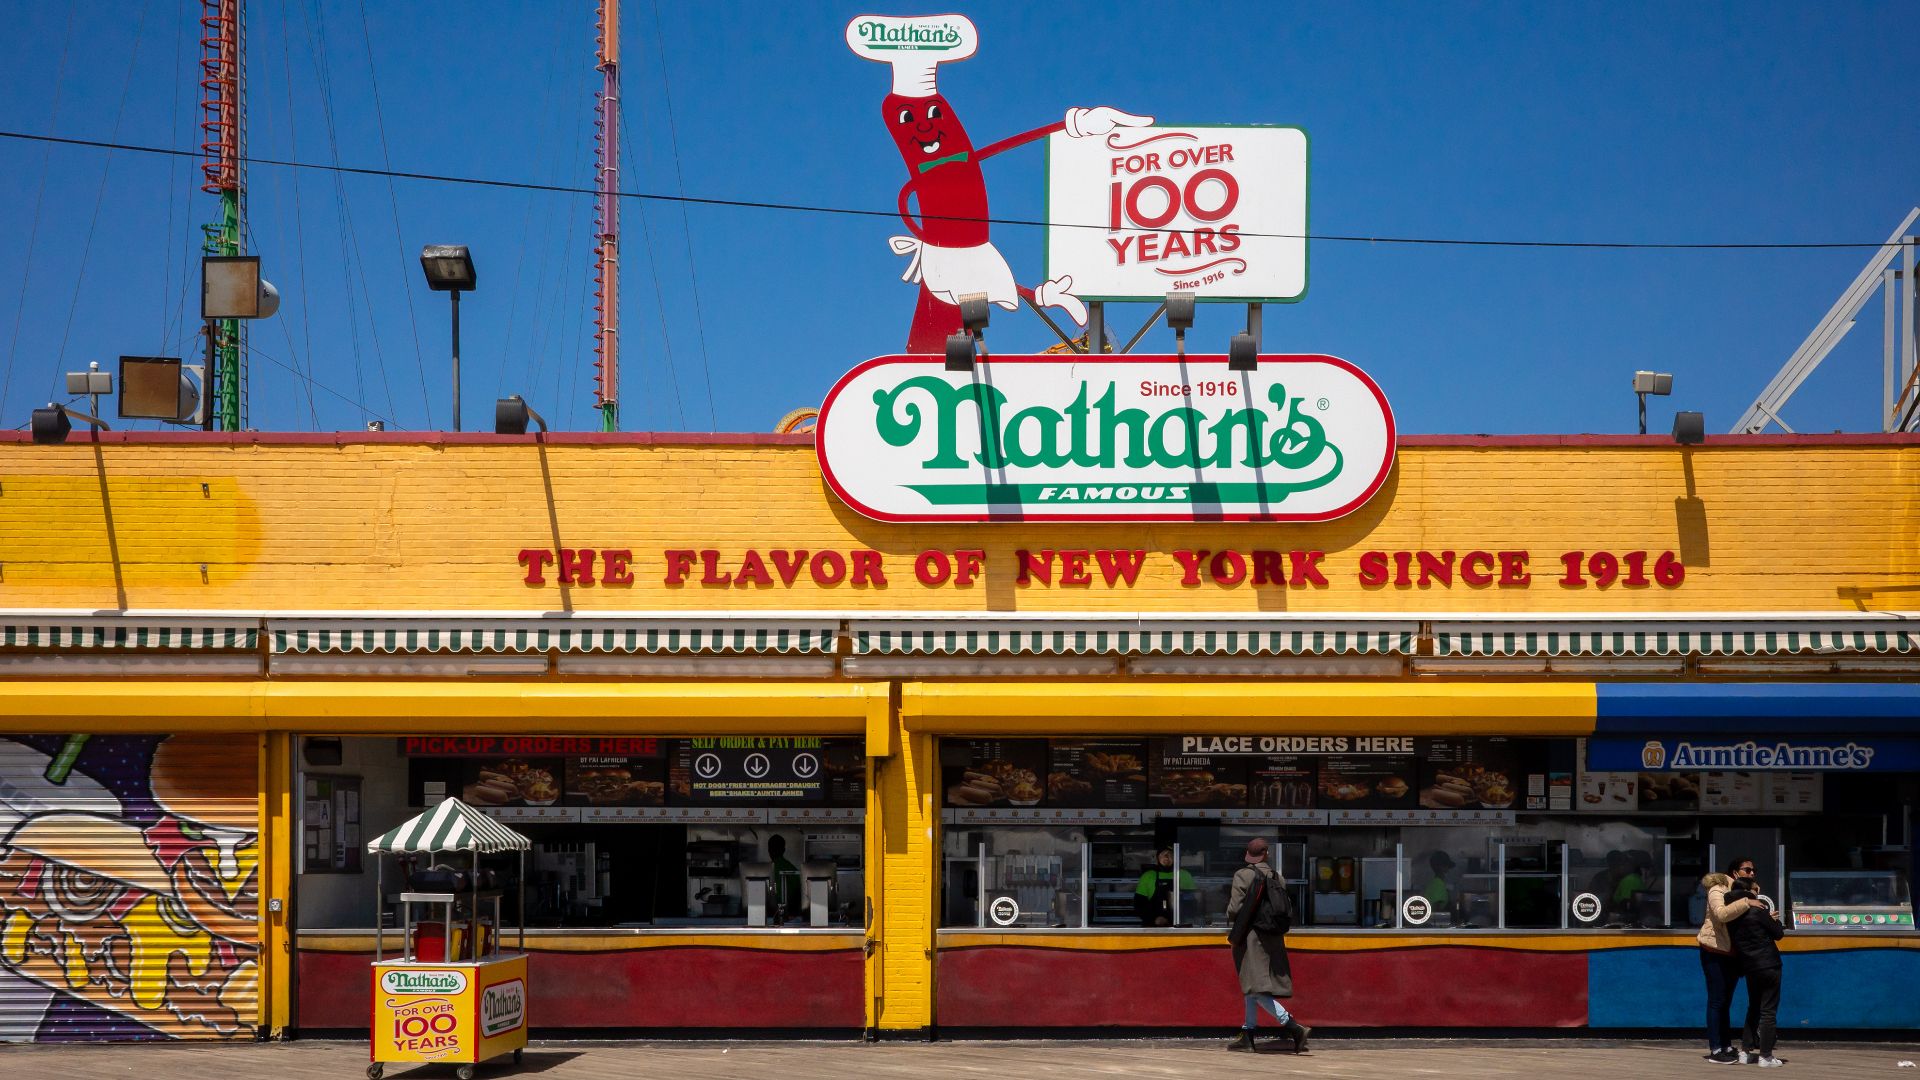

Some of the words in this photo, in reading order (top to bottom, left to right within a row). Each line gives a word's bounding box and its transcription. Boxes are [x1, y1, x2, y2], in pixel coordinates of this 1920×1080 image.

[858, 21, 962, 43] Nathan's
[1111, 152, 1162, 176] FOR
[1168, 143, 1235, 169] OVER
[1110, 168, 1240, 233] 100
[1107, 223, 1241, 265] YEARS
[1173, 278, 1201, 291] Since
[1202, 270, 1226, 287] 1916
[1139, 381, 1192, 397] Since
[1197, 381, 1238, 397] 1916
[873, 376, 1344, 474] Nathan's
[1037, 486, 1190, 501] FAMOUS
[518, 549, 635, 589] THE
[664, 549, 889, 589] FLAVOR
[914, 549, 986, 589] OF
[1015, 549, 1147, 589] NEW
[1174, 549, 1330, 589] YORK
[1358, 549, 1532, 589] SINCE
[1559, 549, 1686, 589] 1916
[406, 737, 496, 753] PICK-UP
[503, 737, 592, 753] ORDERS
[599, 737, 657, 753] HERE
[720, 736, 755, 749] ORDER
[757, 736, 766, 749] &
[769, 736, 789, 749] PAY
[793, 736, 821, 749] HERE
[1182, 737, 1253, 752] PLACE
[1259, 737, 1349, 752] ORDERS
[1355, 737, 1415, 752] HERE
[388, 972, 461, 988] Nathan's
[394, 1007, 419, 1018] FOR
[422, 1004, 455, 1014] OVER
[394, 1013, 457, 1039] 100
[394, 1035, 459, 1051] YEARS
